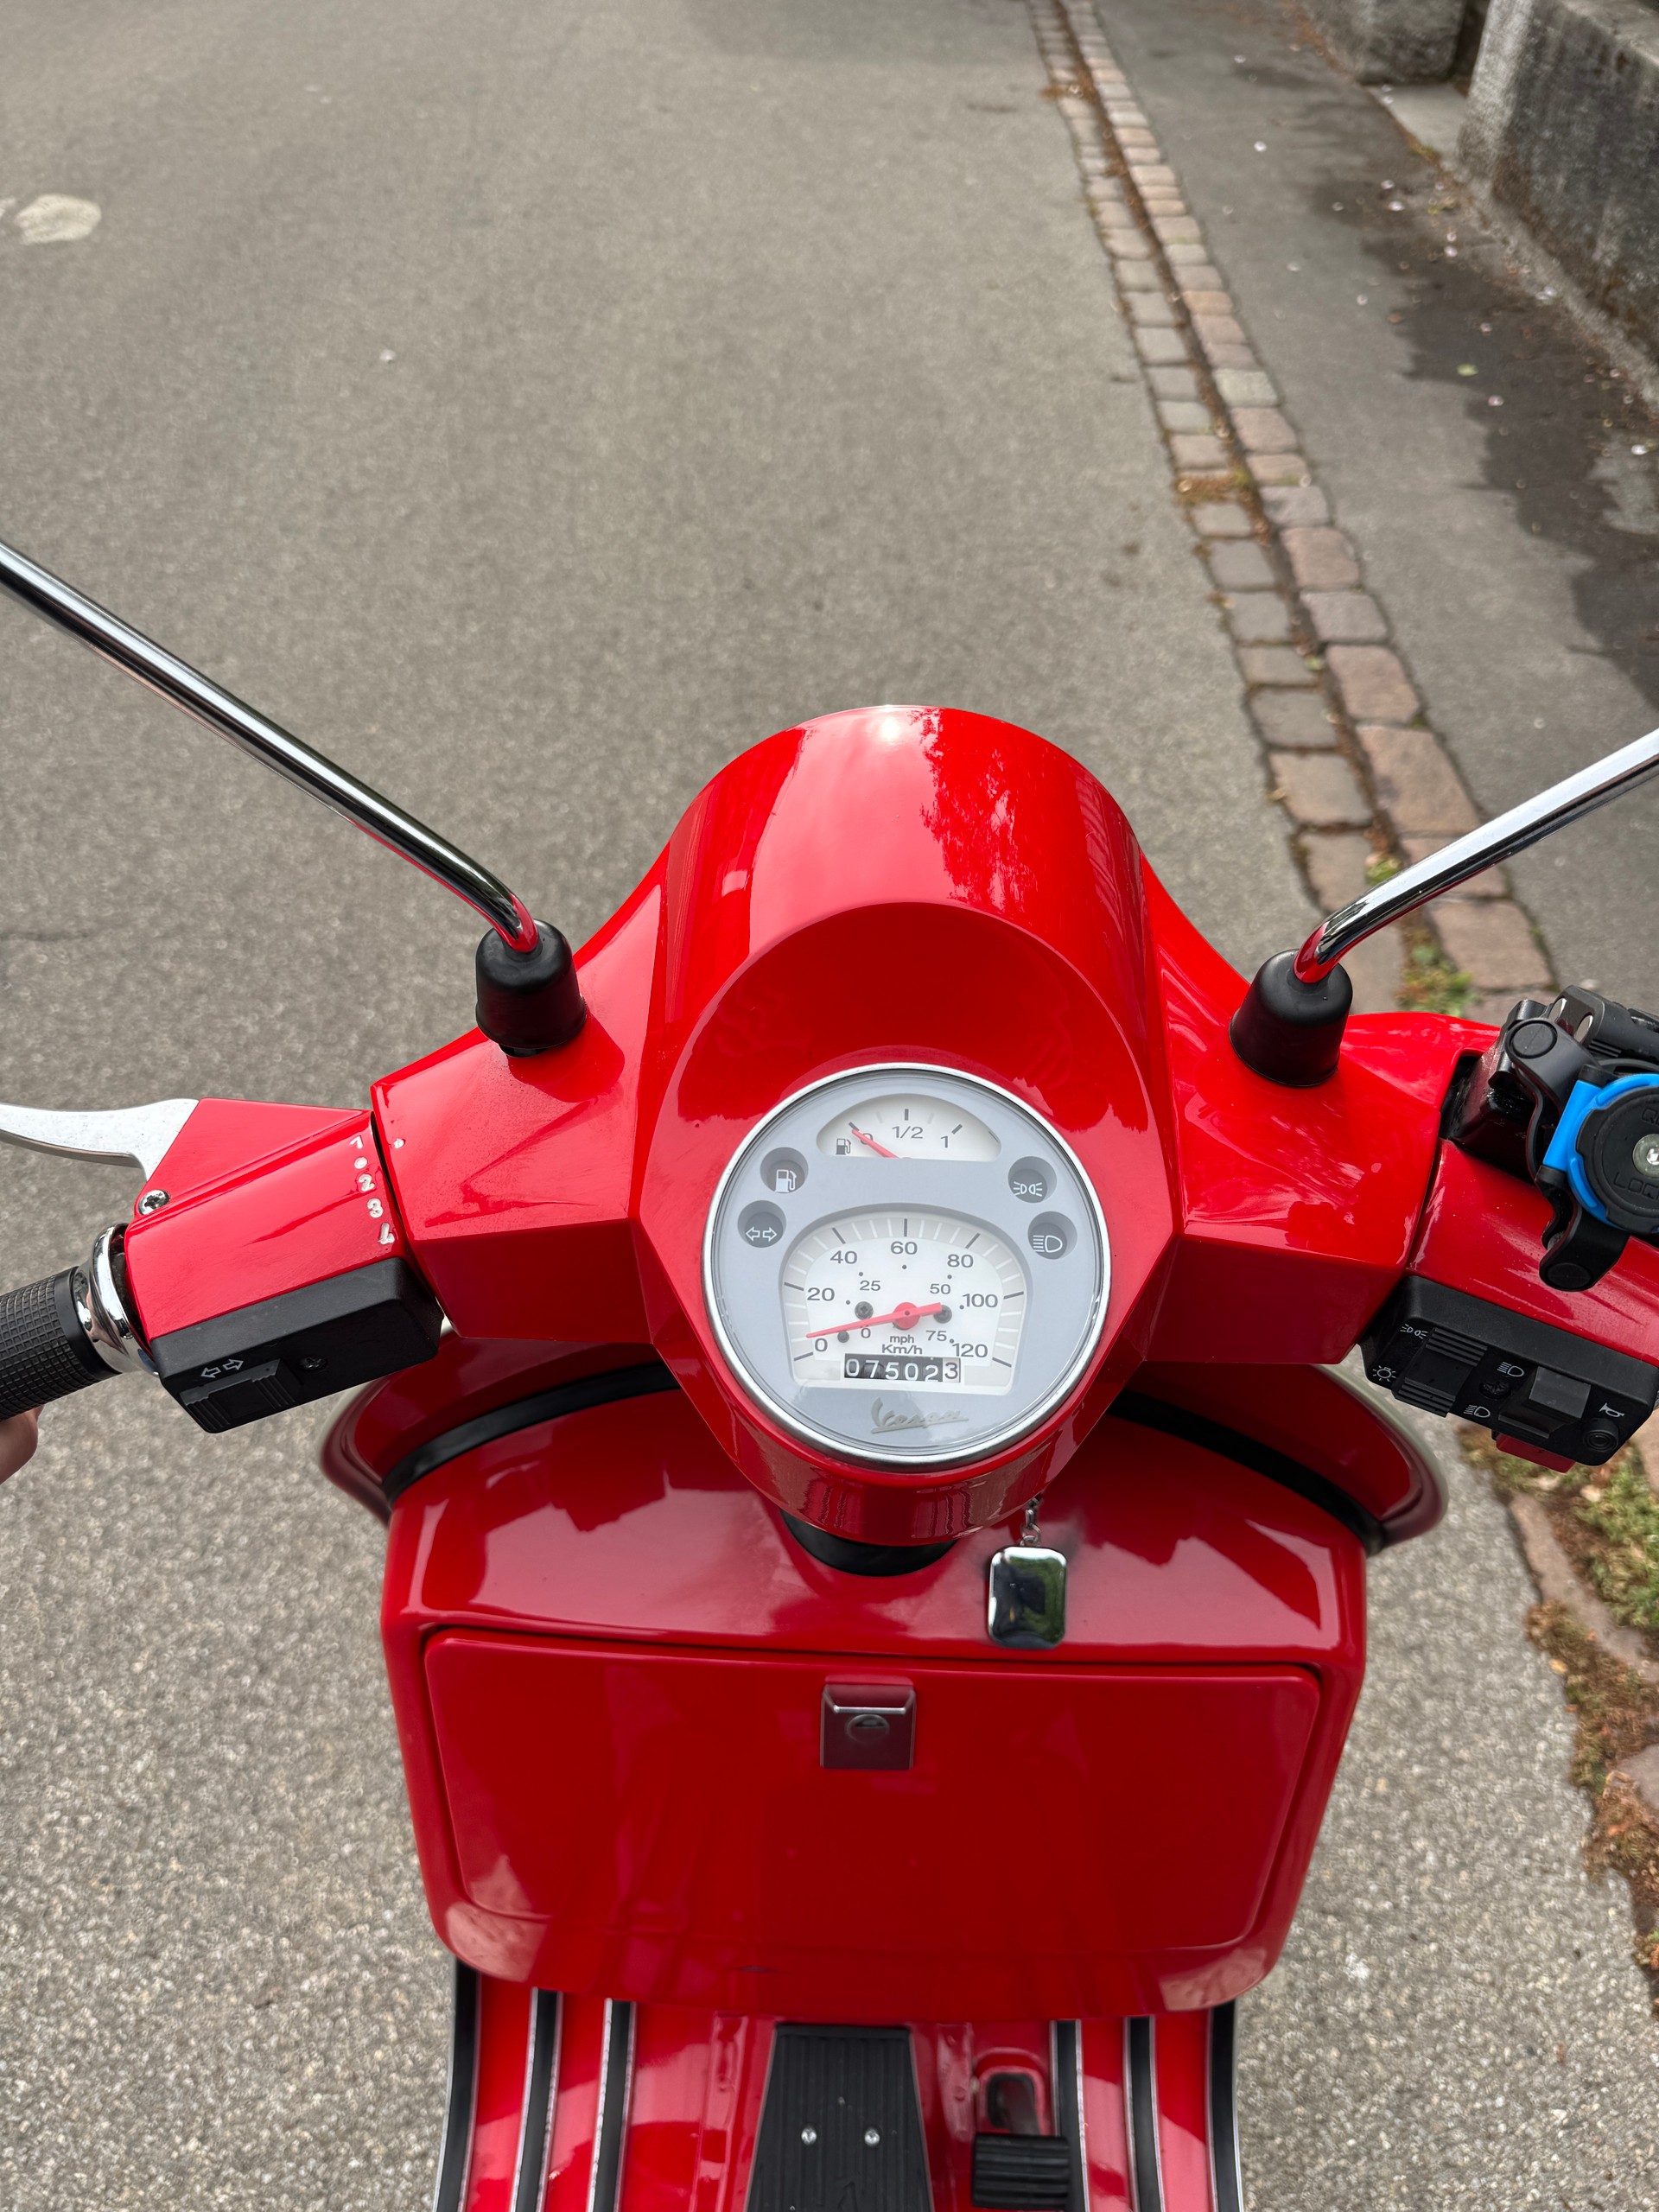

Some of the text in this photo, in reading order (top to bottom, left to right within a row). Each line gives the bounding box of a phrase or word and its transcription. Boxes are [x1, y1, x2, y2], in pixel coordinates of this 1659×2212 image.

[892, 1125, 924, 1140] 1/2
[940, 1135, 949, 1148] 1
[359, 1173, 375, 1192] 2
[1613, 1172, 1659, 1201] LOC
[366, 1198, 384, 1218] 3
[890, 1241, 918, 1255] 60
[830, 1250, 858, 1264] 40
[947, 1254, 974, 1268] 80
[859, 1280, 881, 1292] 25
[929, 1283, 951, 1294] 50
[807, 1287, 836, 1301] 20
[962, 1294, 999, 1307] 100
[861, 1327, 871, 1338] 0
[889, 1334, 915, 1344] mph
[925, 1330, 947, 1342] 75
[814, 1338, 829, 1352] 0
[881, 1344, 923, 1355] Km/h
[952, 1343, 988, 1357] 120
[845, 1358, 958, 1382] 075023
